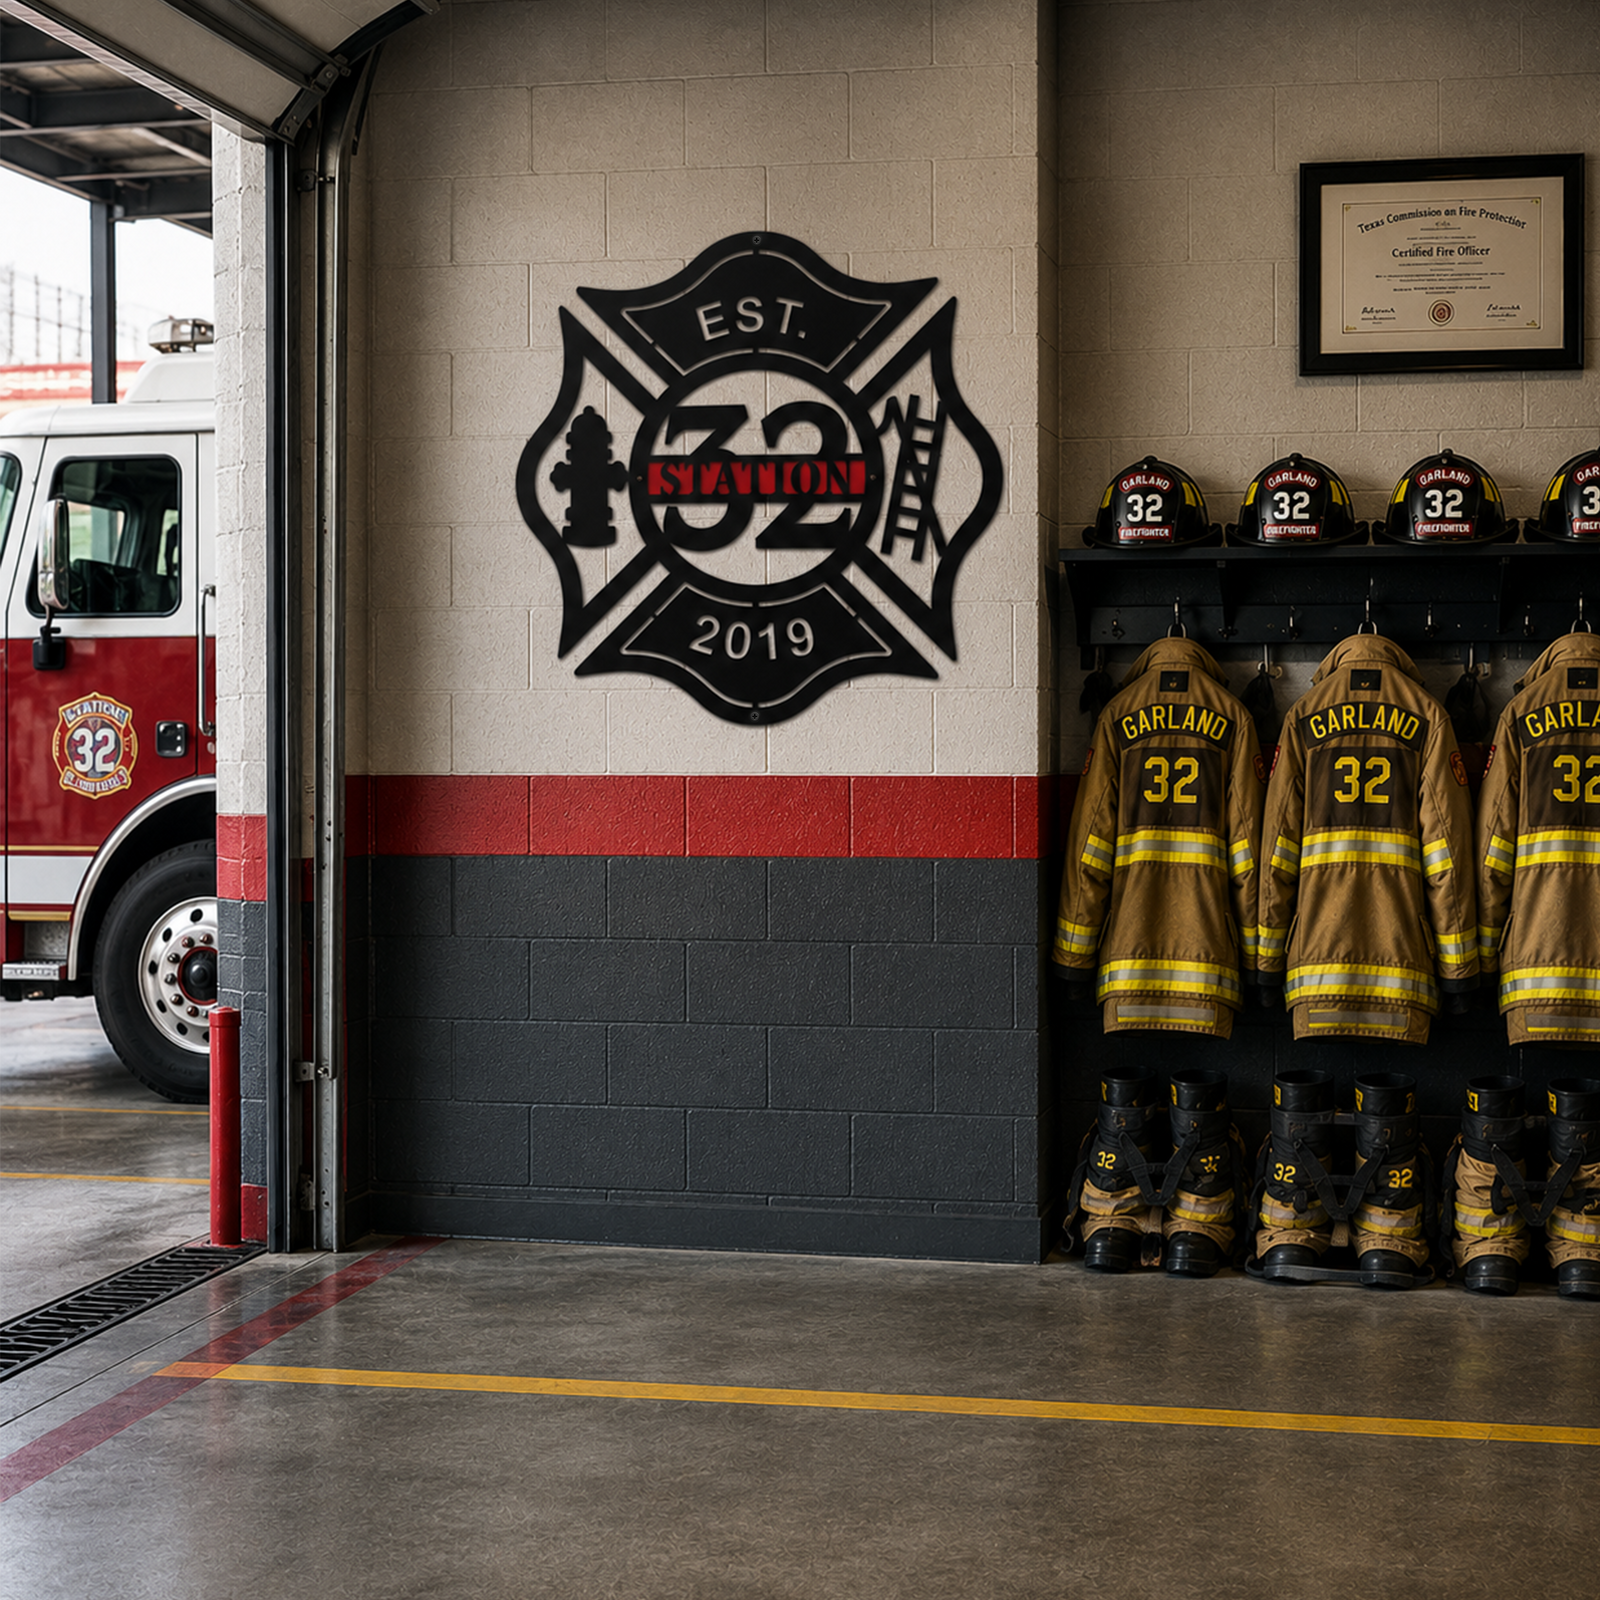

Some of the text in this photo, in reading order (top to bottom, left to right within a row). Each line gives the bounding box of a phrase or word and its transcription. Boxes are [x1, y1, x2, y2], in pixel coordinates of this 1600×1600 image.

[1357, 219, 1385, 233] Texas
[1386, 206, 1442, 223] Commission
[1459, 206, 1477, 217] Fire
[1392, 245, 1491, 258] Certified Fire Officer
[696, 296, 807, 342] EST.
[659, 460, 851, 497] STATION
[663, 400, 852, 552] 32
[1122, 474, 1170, 490] GARLAND
[1267, 471, 1318, 488] GARLAND
[1419, 469, 1471, 486] GARLAND
[1127, 493, 1163, 522] 32
[1273, 491, 1310, 520] 32
[1425, 489, 1463, 518] 32
[1582, 485, 1600, 515] 3
[688, 615, 815, 661] 2019
[1121, 704, 1228, 740] GARLAND
[1309, 703, 1420, 740] GARLAND
[72, 727, 116, 773] 32
[1143, 756, 1199, 803] 32
[1334, 756, 1391, 803] 32
[1097, 1151, 1116, 1170] 32
[1273, 1162, 1297, 1184] 32
[1388, 1168, 1413, 1189] 32
